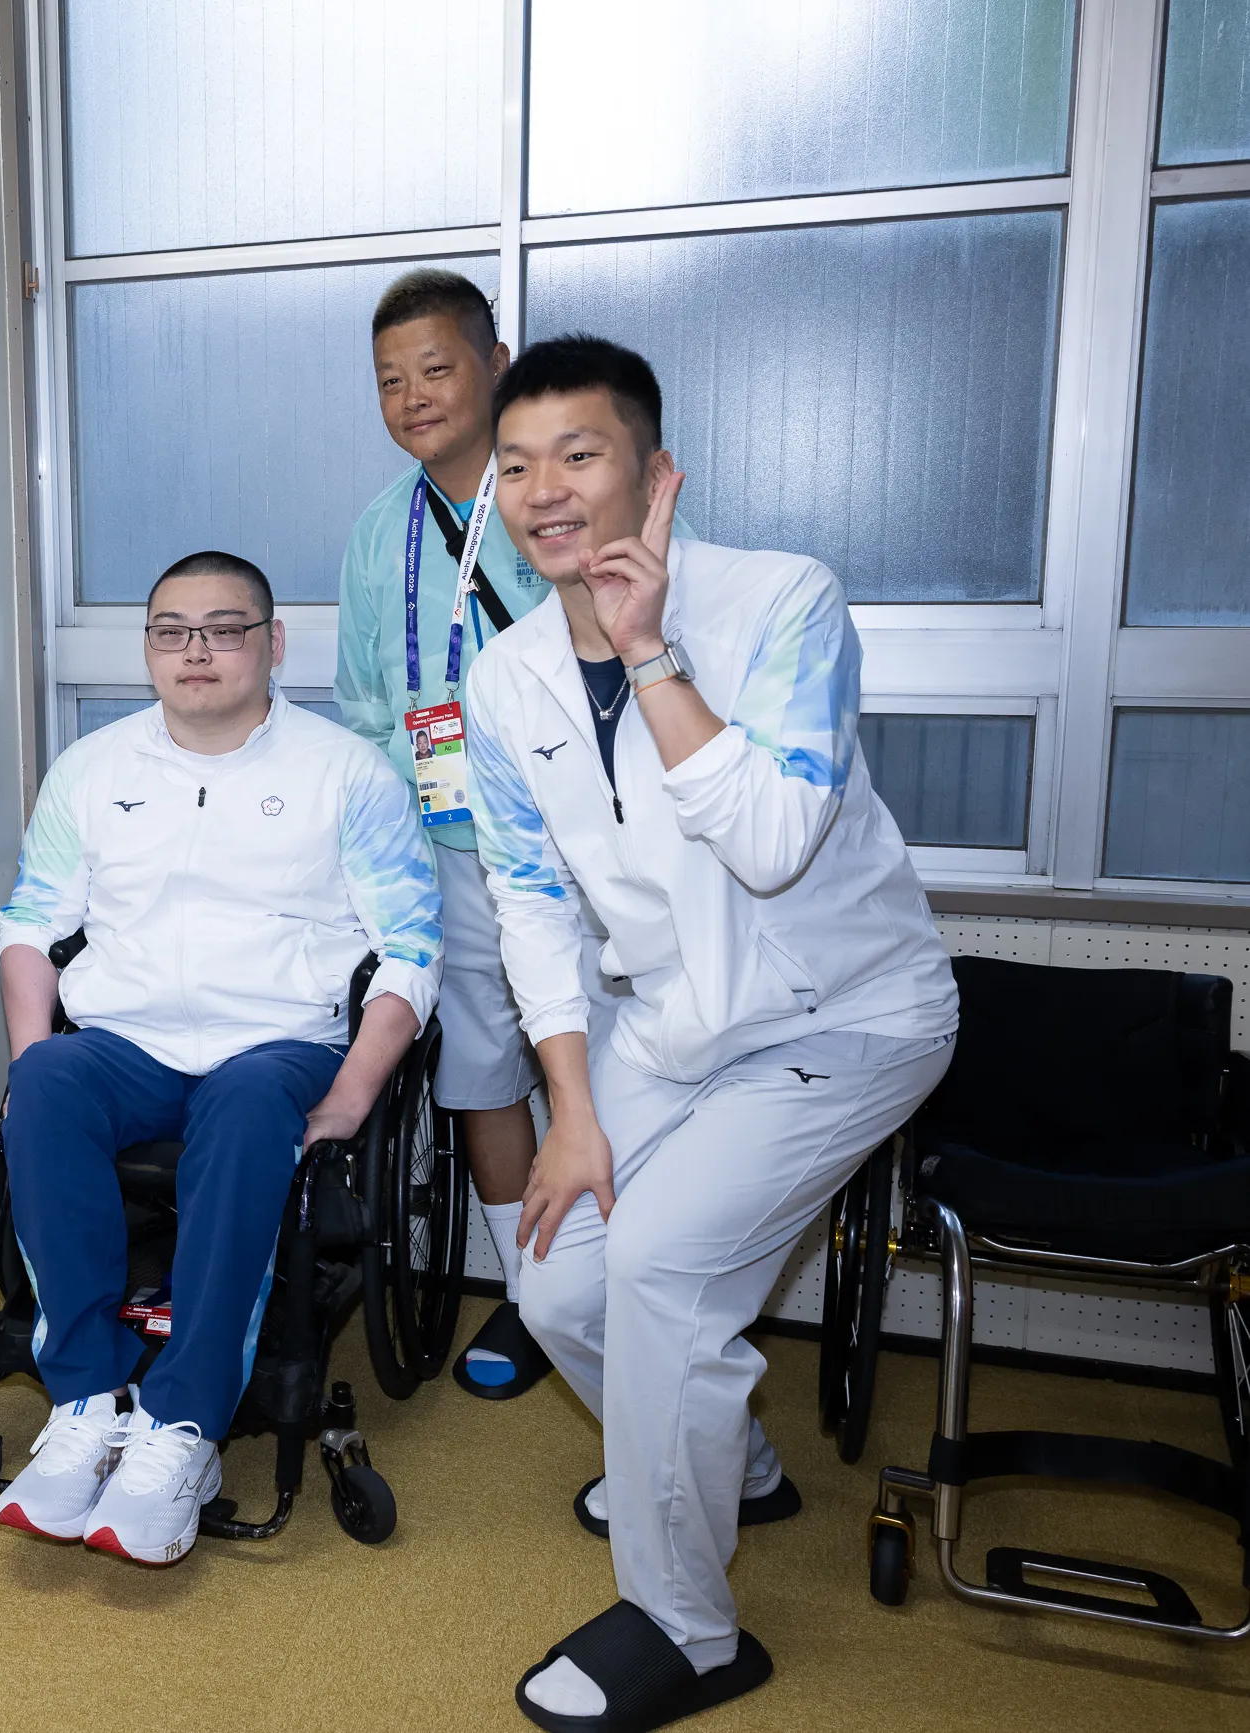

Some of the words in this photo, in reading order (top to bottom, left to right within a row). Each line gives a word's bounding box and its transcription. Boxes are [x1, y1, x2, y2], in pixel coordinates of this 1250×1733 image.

[407, 518, 419, 572] Aichi-Nagoya
[461, 526, 481, 581] Aichi-Nagoya
[475, 503, 487, 525] 2026
[447, 813, 453, 821] 2
[164, 1538, 182, 1561] TPE
